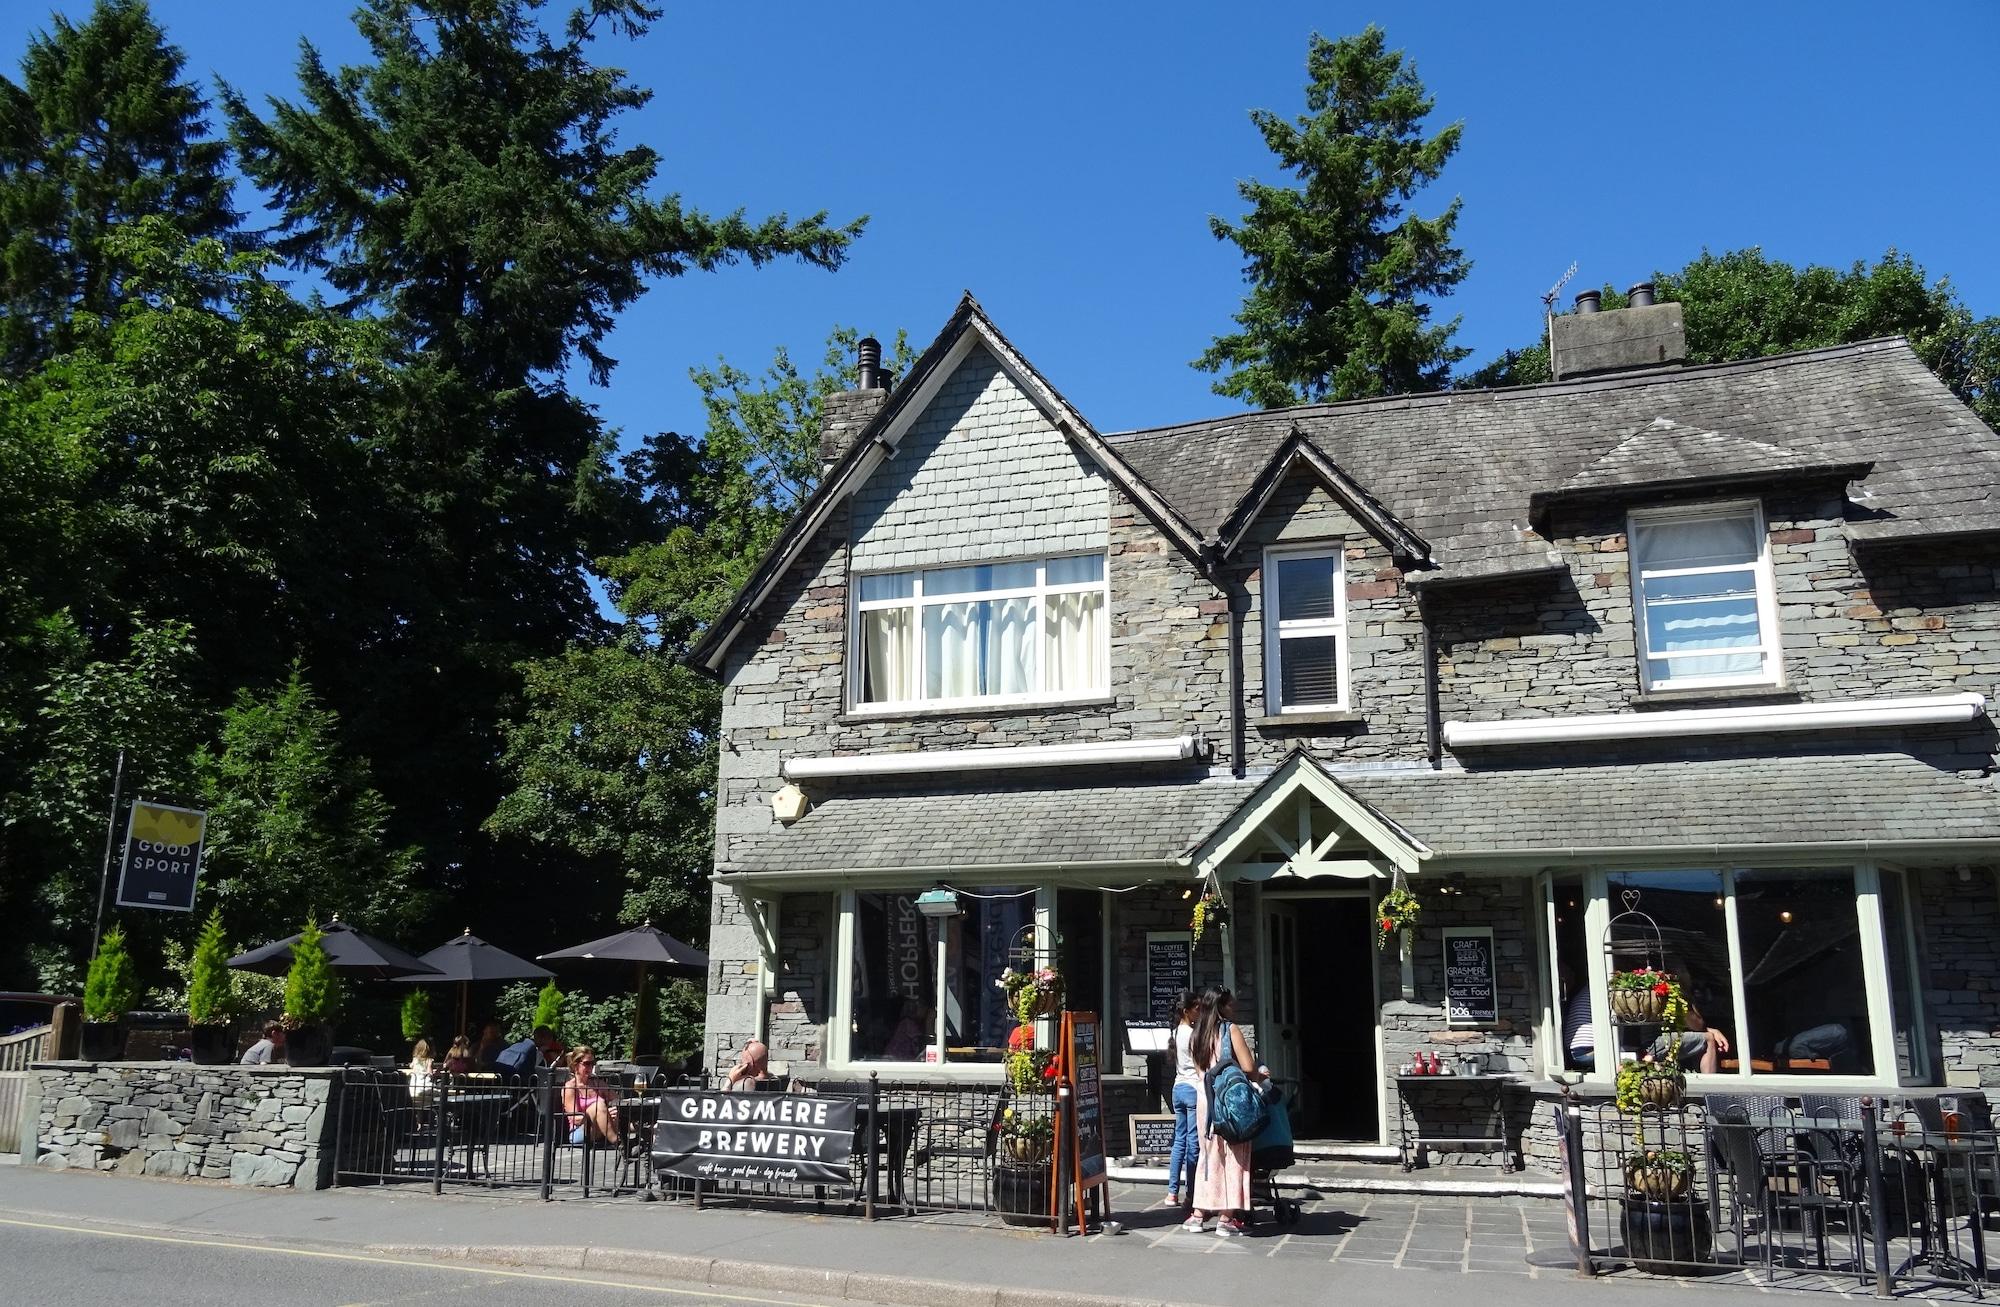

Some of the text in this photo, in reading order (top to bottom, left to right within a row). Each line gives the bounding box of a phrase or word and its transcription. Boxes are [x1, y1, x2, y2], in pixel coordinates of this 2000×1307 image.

[139, 840, 190, 857] GOOD
[134, 856, 190, 874] SPORT
[1453, 940, 1480, 949] CRAFT
[1448, 967, 1487, 975] GRASMERE
[1152, 986, 1173, 995] Sunday
[1449, 987, 1490, 996] Great Food
[1450, 1007, 1470, 1016] DOG
[681, 1097, 828, 1125] GRASMERE
[698, 1130, 826, 1157] BREWERY
[697, 1164, 798, 1181] craft beer good food dog friendly
